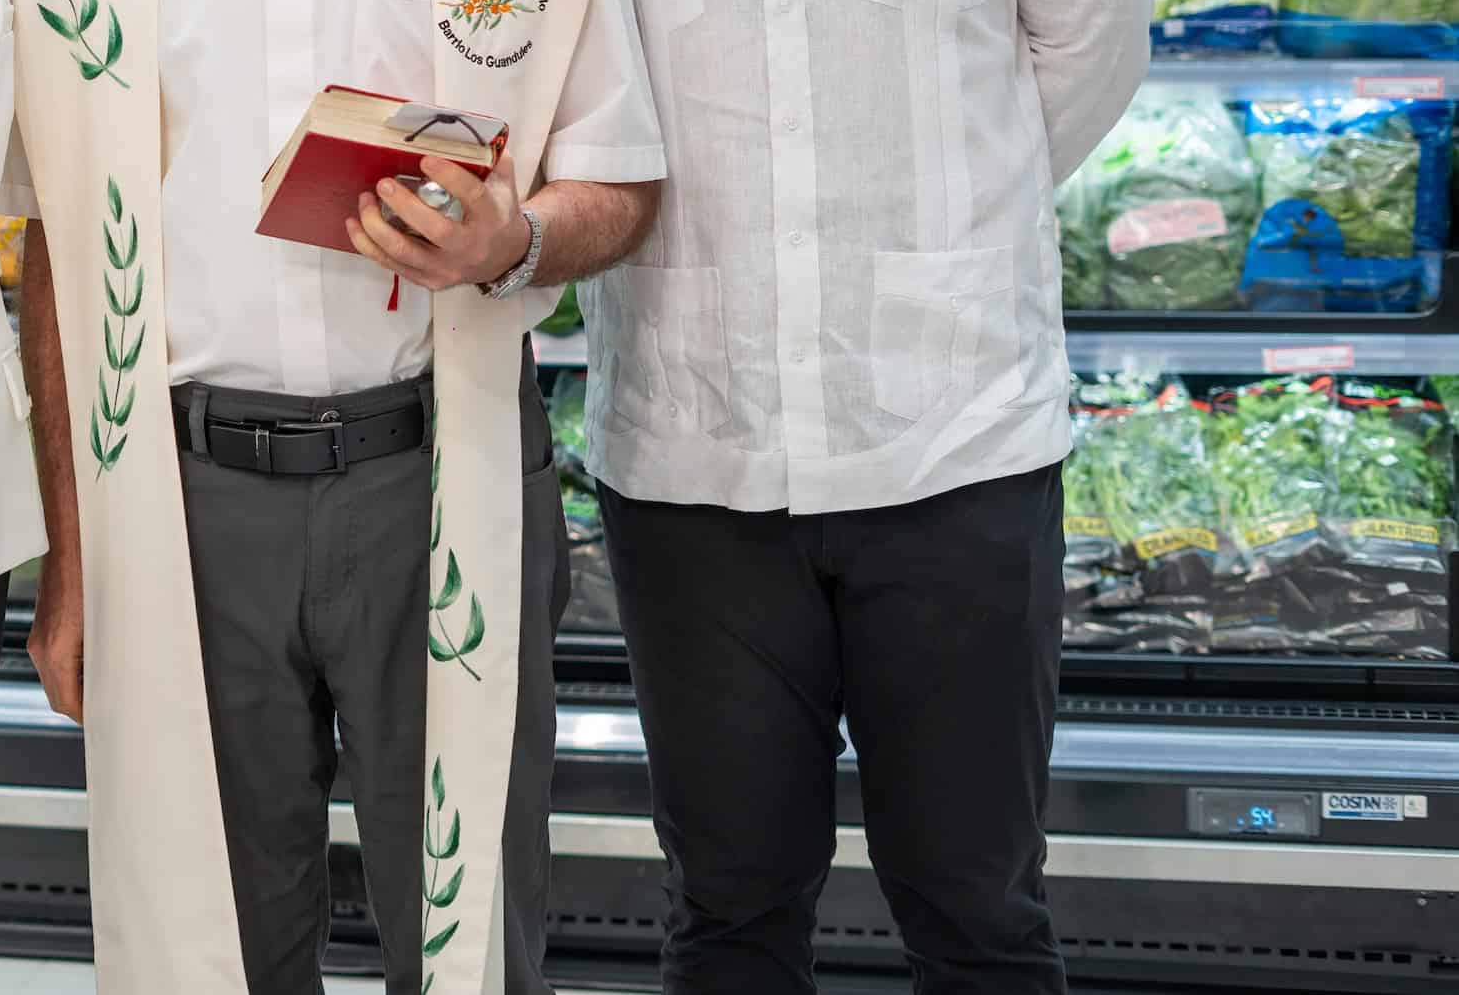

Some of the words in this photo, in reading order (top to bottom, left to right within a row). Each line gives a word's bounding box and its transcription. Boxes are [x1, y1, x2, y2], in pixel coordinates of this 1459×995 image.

[438, 19, 466, 54] Barrio
[464, 47, 484, 65] Los
[1328, 795, 1381, 810] COSTAN
